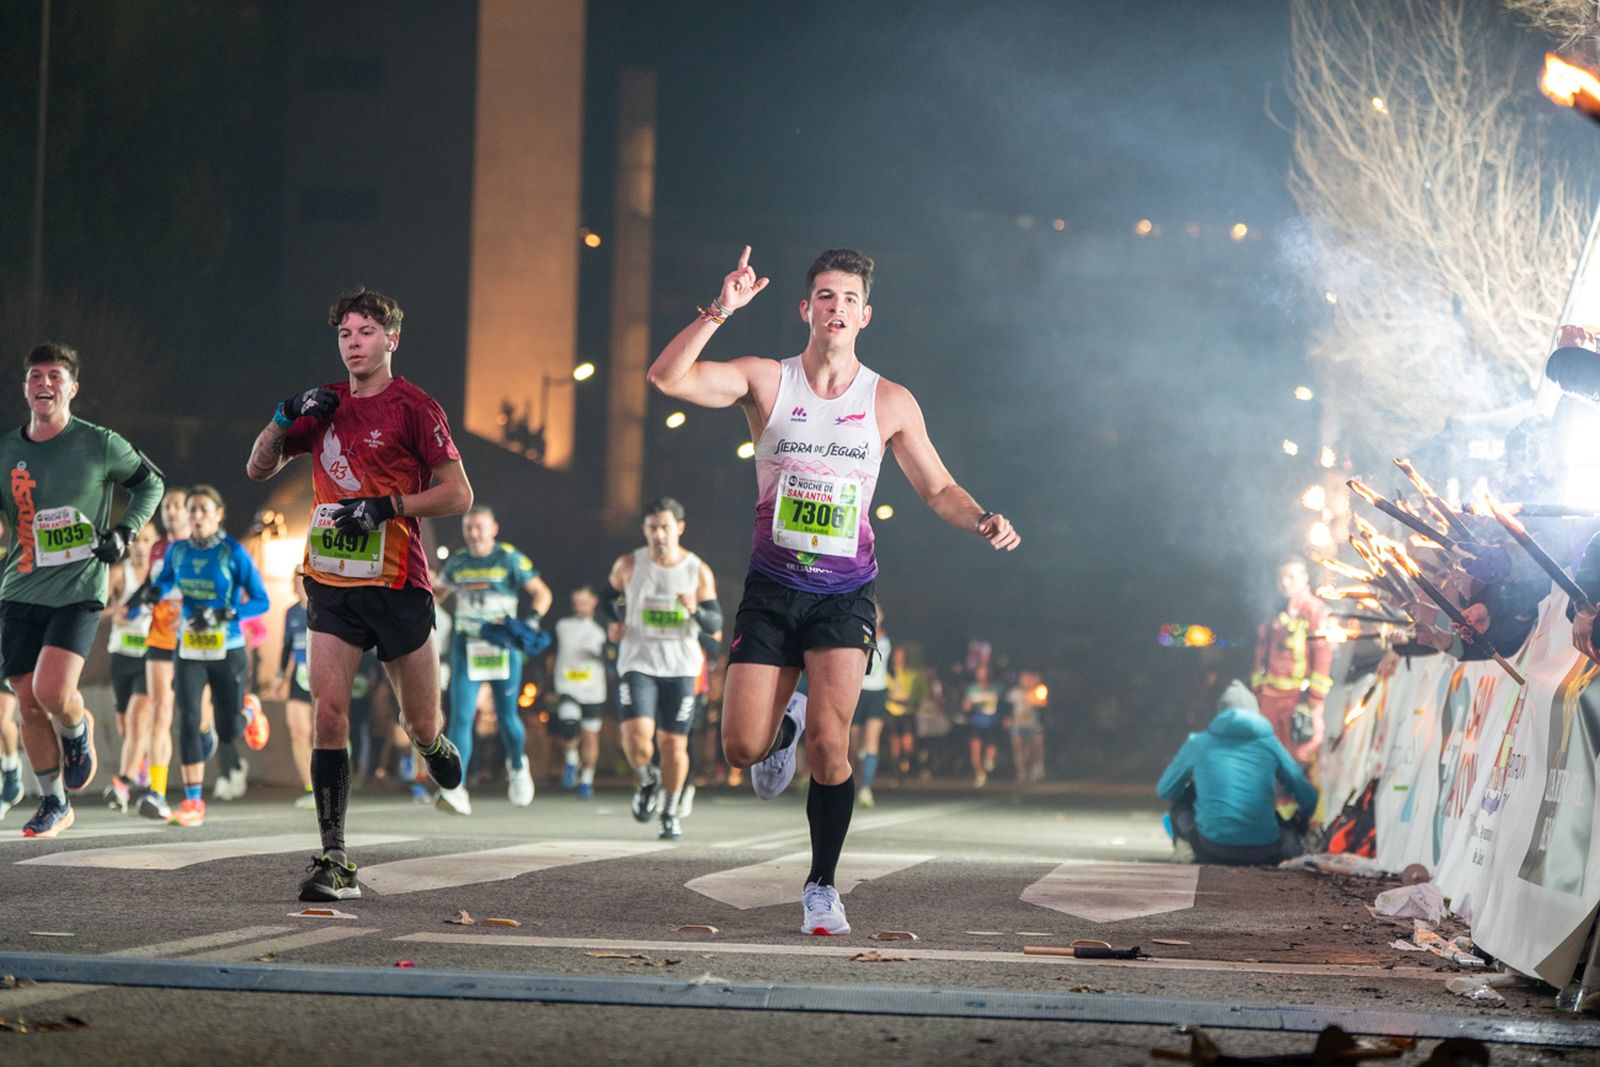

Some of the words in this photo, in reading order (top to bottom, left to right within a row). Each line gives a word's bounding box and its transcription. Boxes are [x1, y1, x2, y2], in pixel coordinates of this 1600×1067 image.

[775, 439, 812, 455] SIERRA
[814, 445, 825, 454] DE
[822, 443, 866, 460] SEGURA
[330, 461, 348, 480] 43
[787, 489, 803, 499] SAN
[797, 481, 822, 492] NOCHE
[824, 485, 834, 493] DE
[792, 500, 845, 529] 7306
[44, 524, 84, 546] 7035
